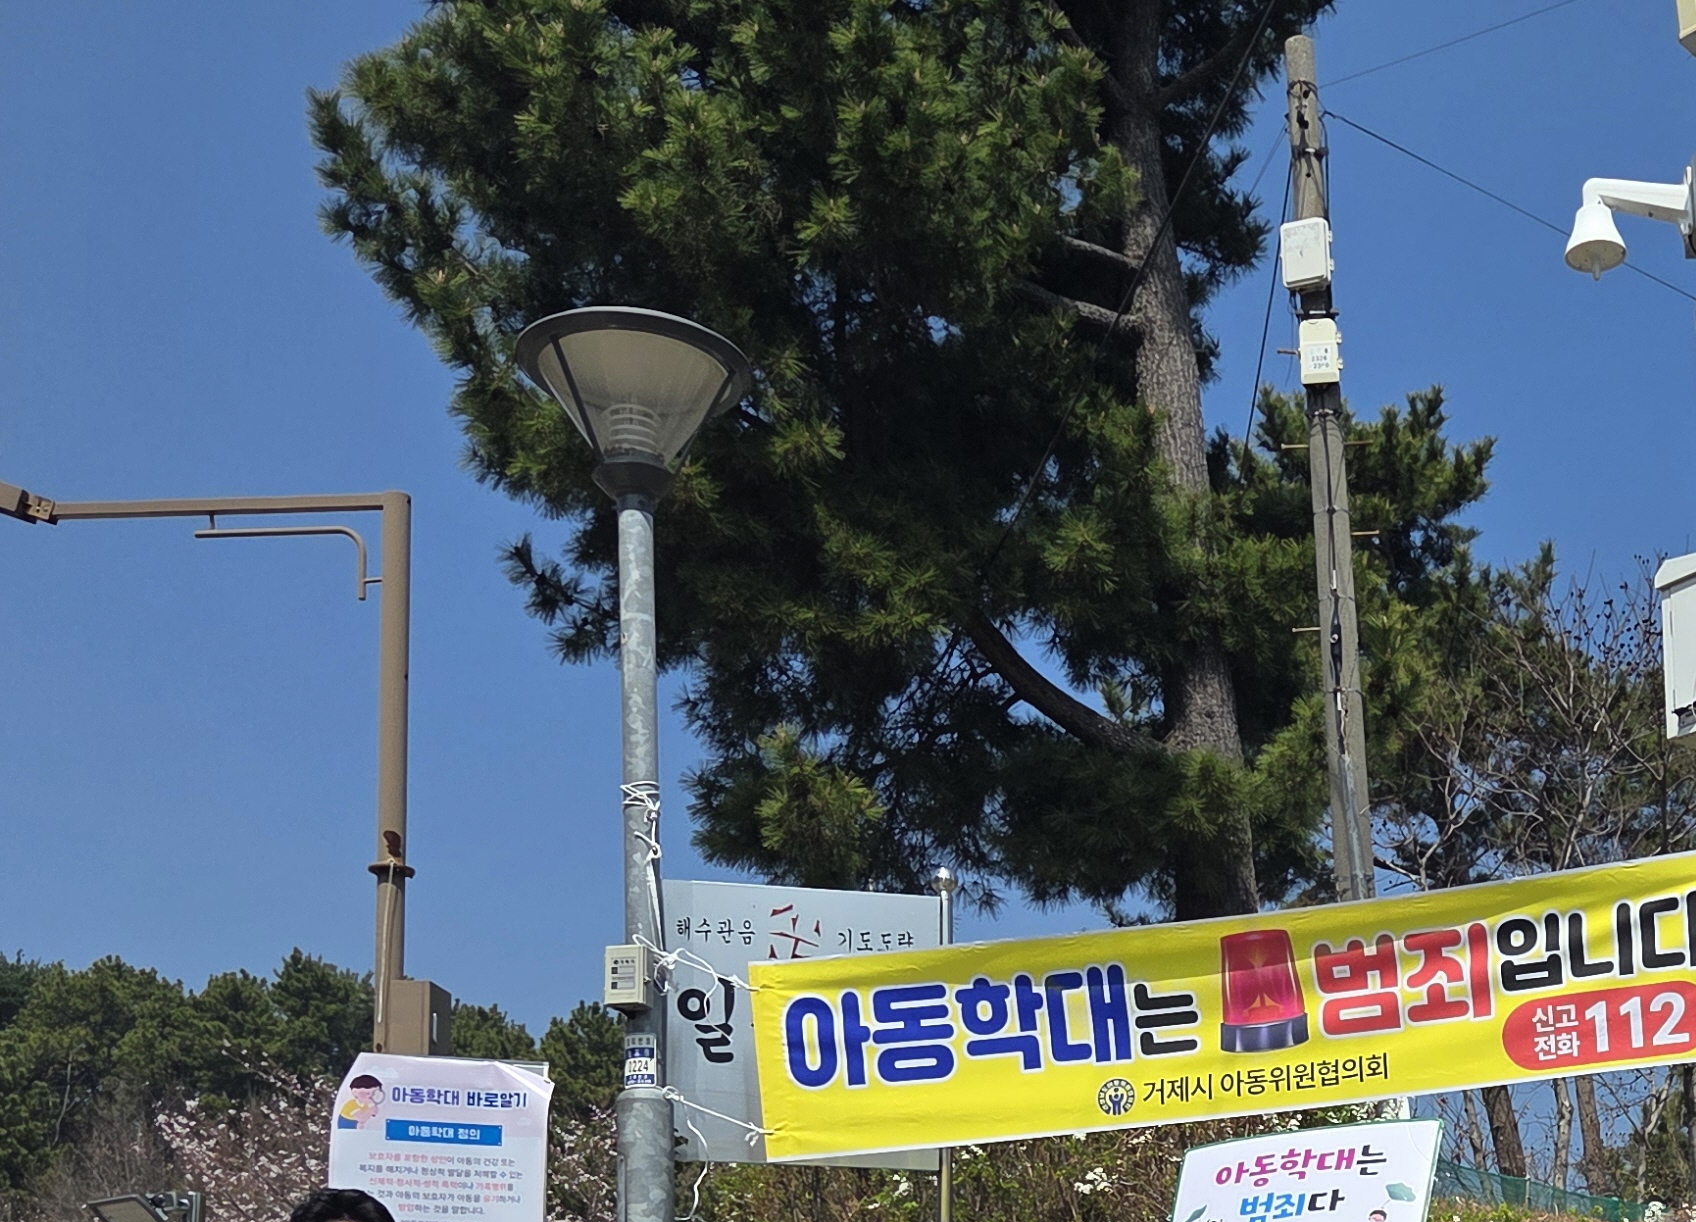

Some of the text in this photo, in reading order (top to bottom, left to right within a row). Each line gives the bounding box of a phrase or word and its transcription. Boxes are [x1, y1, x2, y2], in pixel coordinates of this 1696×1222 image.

[676, 916, 756, 945] 해수관음
[785, 963, 1198, 1087] 아동학대는
[1531, 1004, 1579, 1032] 신고
[1584, 993, 1690, 1053] 112
[1534, 1033, 1580, 1061] 전화
[1143, 1074, 1213, 1105] 거제시
[1220, 1052, 1389, 1097] 아동위원협의회
[392, 1087, 527, 1108] 아동학대 바로알기
[408, 1125, 481, 1140] 아동학대 정의
[1215, 1144, 1387, 1187] 아동학대는
